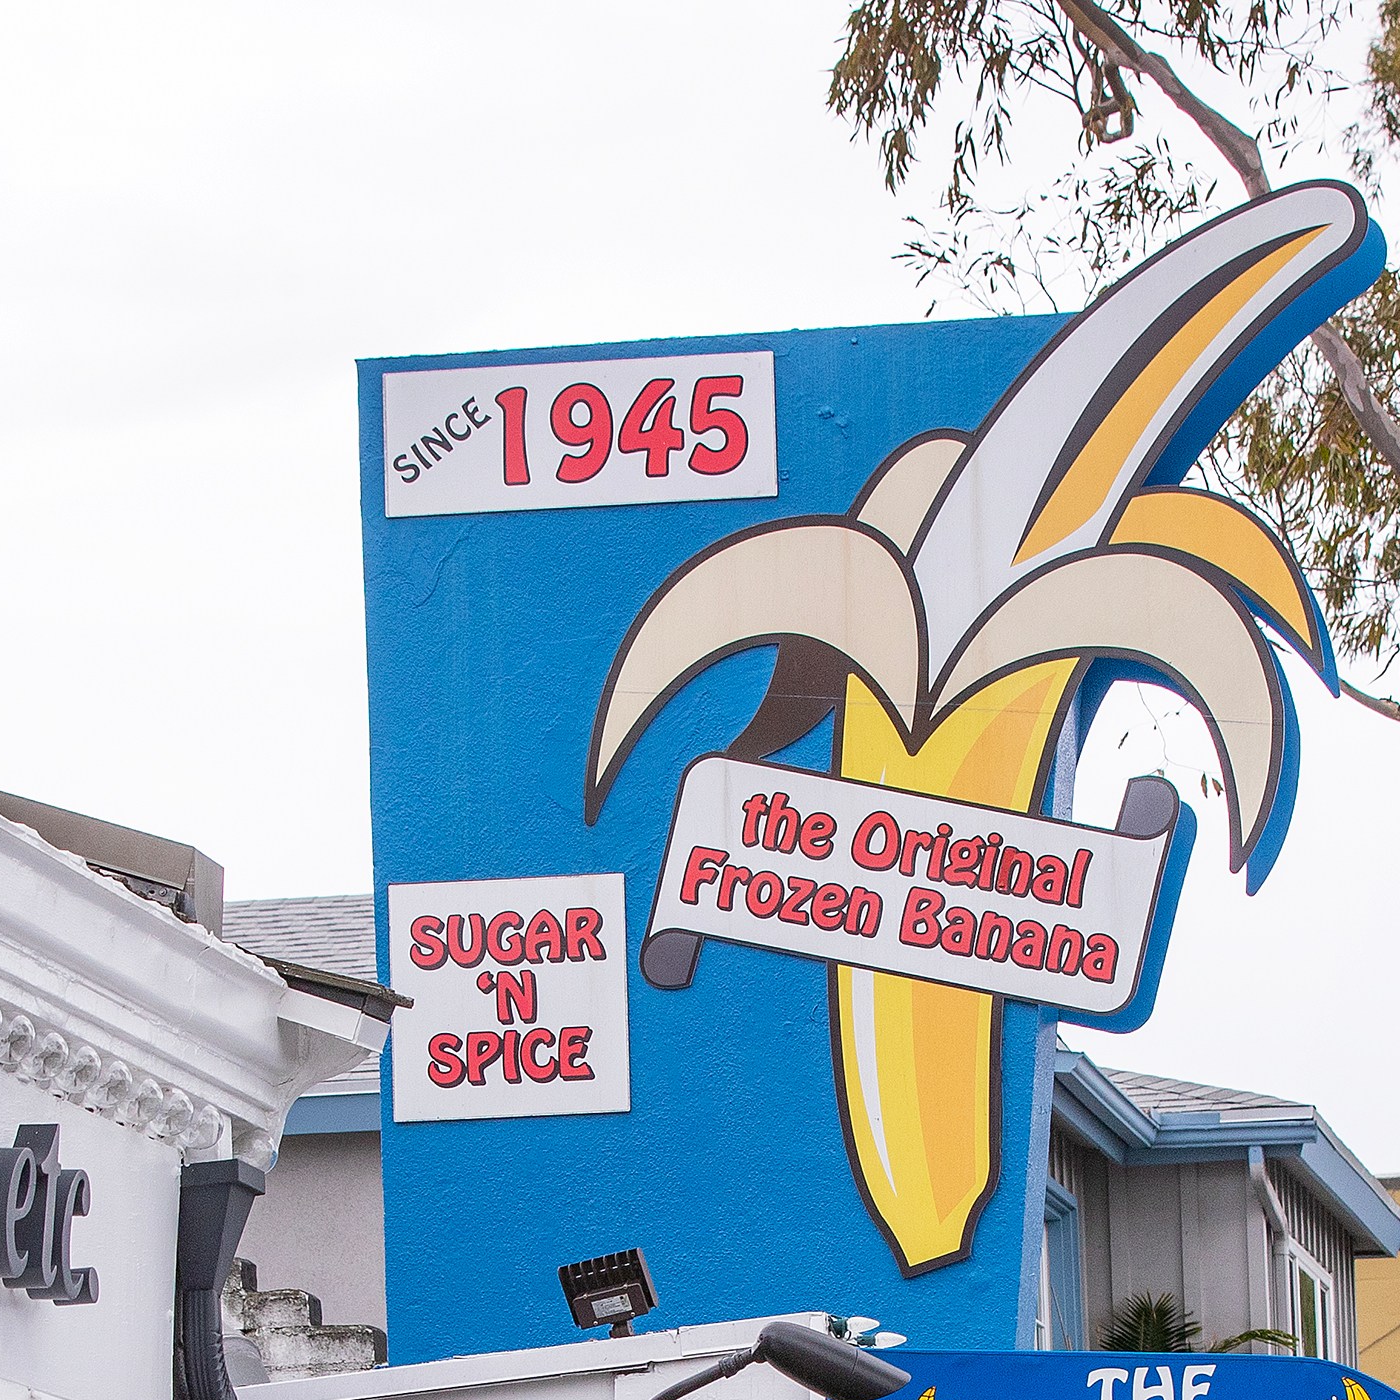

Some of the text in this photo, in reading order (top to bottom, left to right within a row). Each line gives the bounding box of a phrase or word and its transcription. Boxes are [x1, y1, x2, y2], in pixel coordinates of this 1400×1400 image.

[392, 375, 750, 486] SINCE 1945
[741, 791, 1093, 909] the Original
[409, 906, 606, 971] SUGAR
[680, 848, 1119, 985] Frozen Banana
[427, 1025, 595, 1087] SPICE
